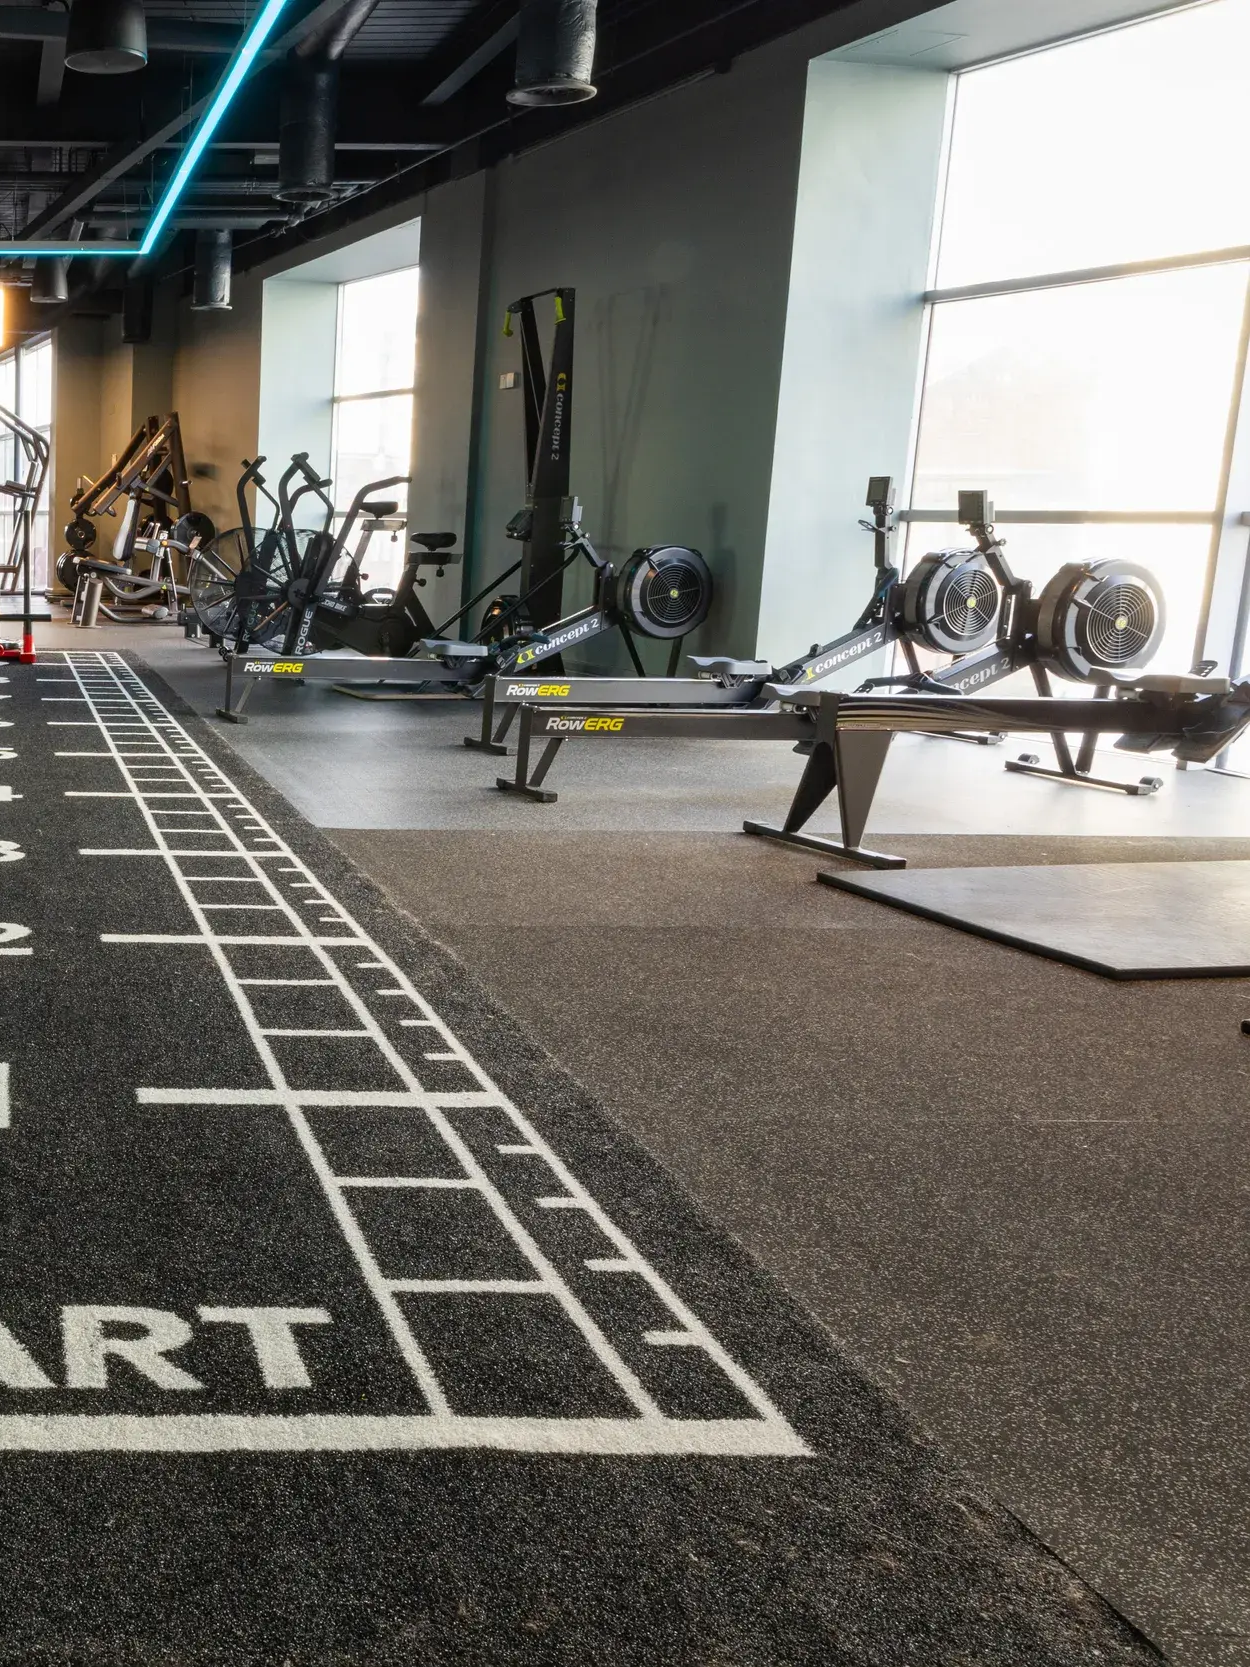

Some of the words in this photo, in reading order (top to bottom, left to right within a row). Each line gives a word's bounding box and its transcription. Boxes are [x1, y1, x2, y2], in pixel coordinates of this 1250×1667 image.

[551, 393, 564, 450] concept
[243, 601, 260, 642] RGUE
[295, 608, 313, 655] ROGUE
[535, 623, 590, 655] concept
[591, 618, 600, 628] 2
[815, 639, 873, 674] concept
[874, 631, 883, 643] 2
[1000, 656, 1011, 669] 2
